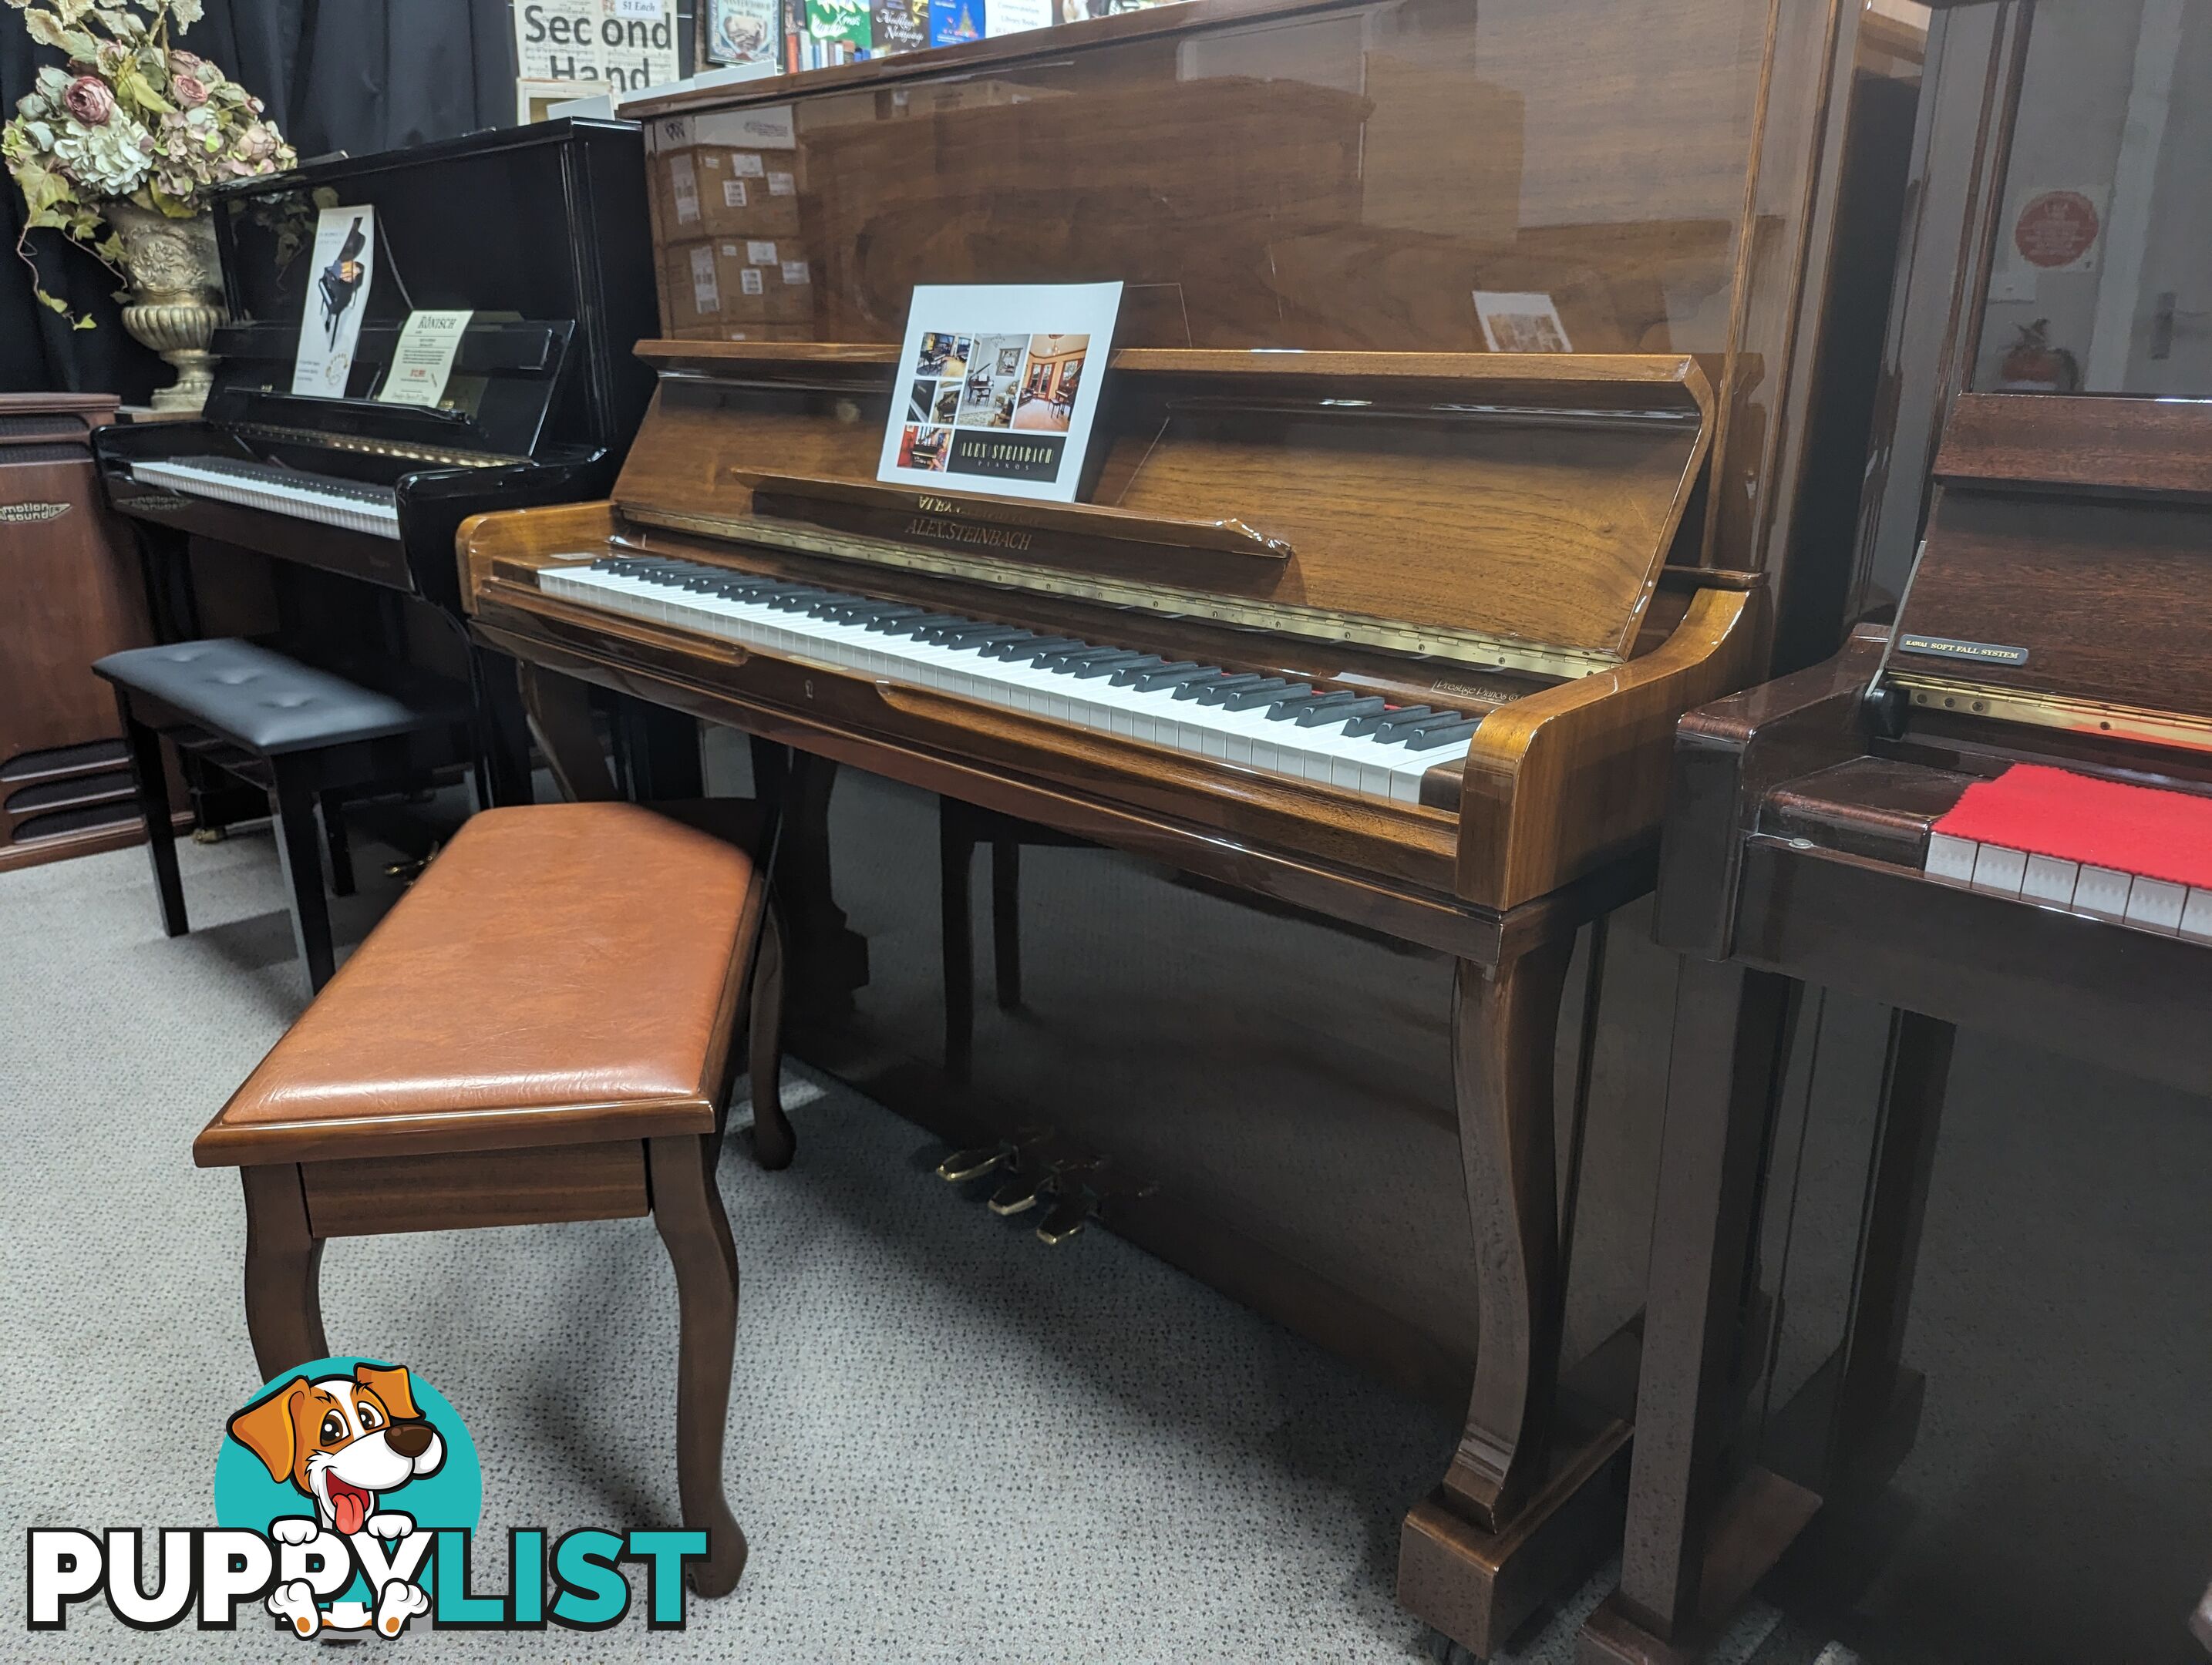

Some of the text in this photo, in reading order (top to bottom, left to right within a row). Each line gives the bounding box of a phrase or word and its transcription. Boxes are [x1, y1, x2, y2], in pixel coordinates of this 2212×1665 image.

[622, 1, 632, 10] $1
[635, 2, 655, 12] Each
[833, 9, 861, 26] Xmas
[524, 5, 672, 50] Second
[550, 55, 650, 92] Hand
[961, 442, 1054, 464] ALEX STEINBACH
[978, 460, 1029, 471] PIANOS
[3, 503, 49, 513] motion
[7, 512, 49, 522] sound
[1930, 642, 1955, 652] SOFT
[1955, 645, 1980, 655] FALL
[1981, 648, 2019, 660] SYSTEM
[1436, 679, 1476, 696] Prestige
[1476, 687, 1507, 701] Pianos
